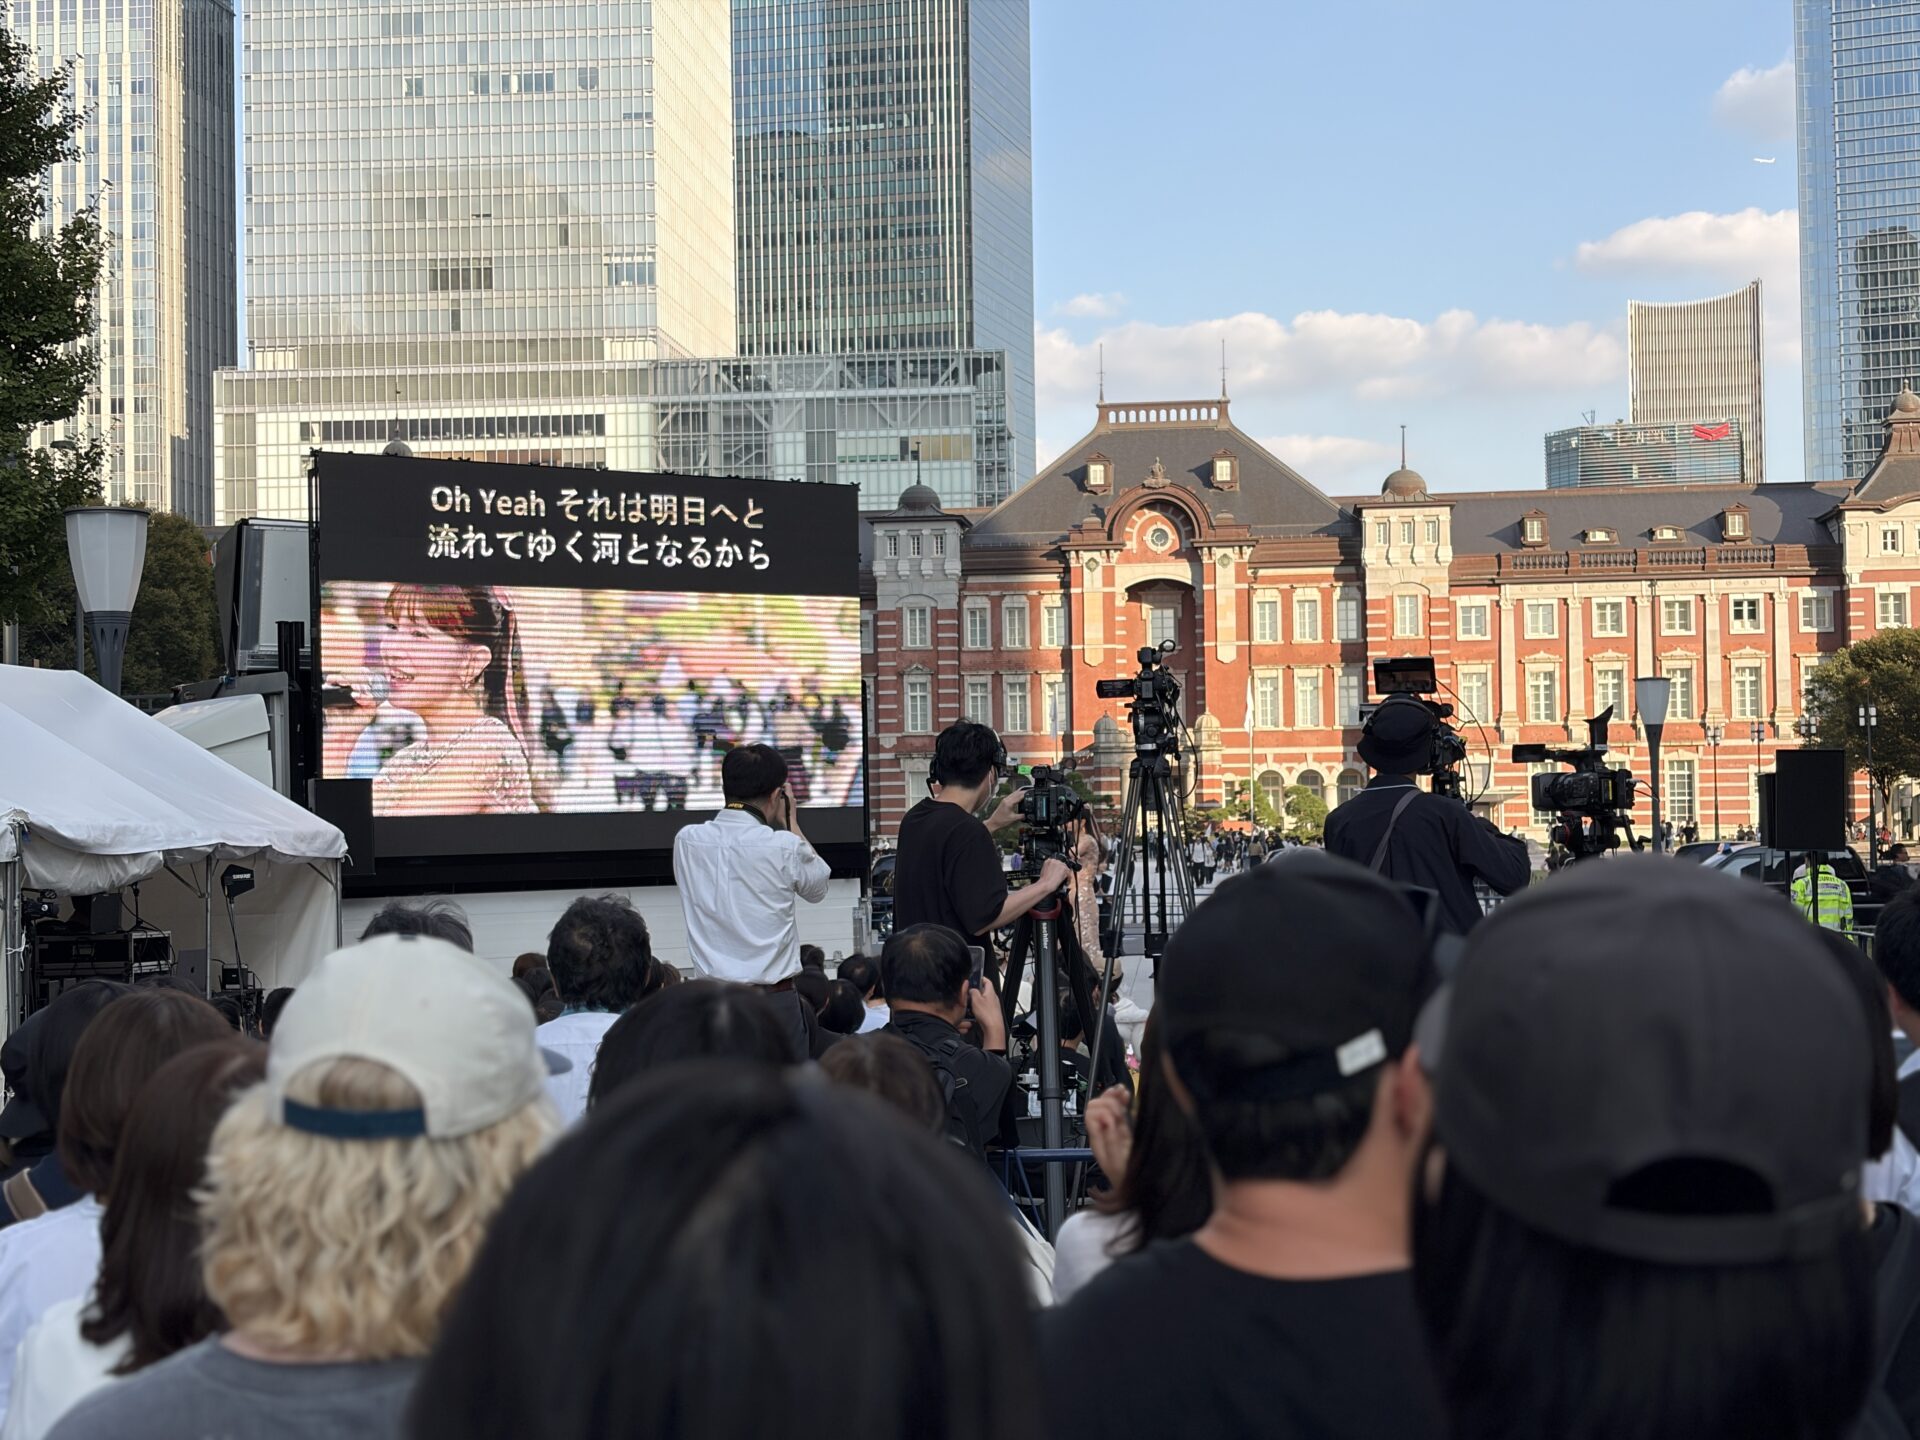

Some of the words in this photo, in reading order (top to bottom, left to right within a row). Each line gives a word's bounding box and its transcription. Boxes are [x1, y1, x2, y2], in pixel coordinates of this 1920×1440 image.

[430, 485, 471, 513] Oh
[478, 488, 546, 518] Yeah
[556, 488, 764, 529] それは明日へと
[427, 522, 770, 570] 流れてゆく河となるから
